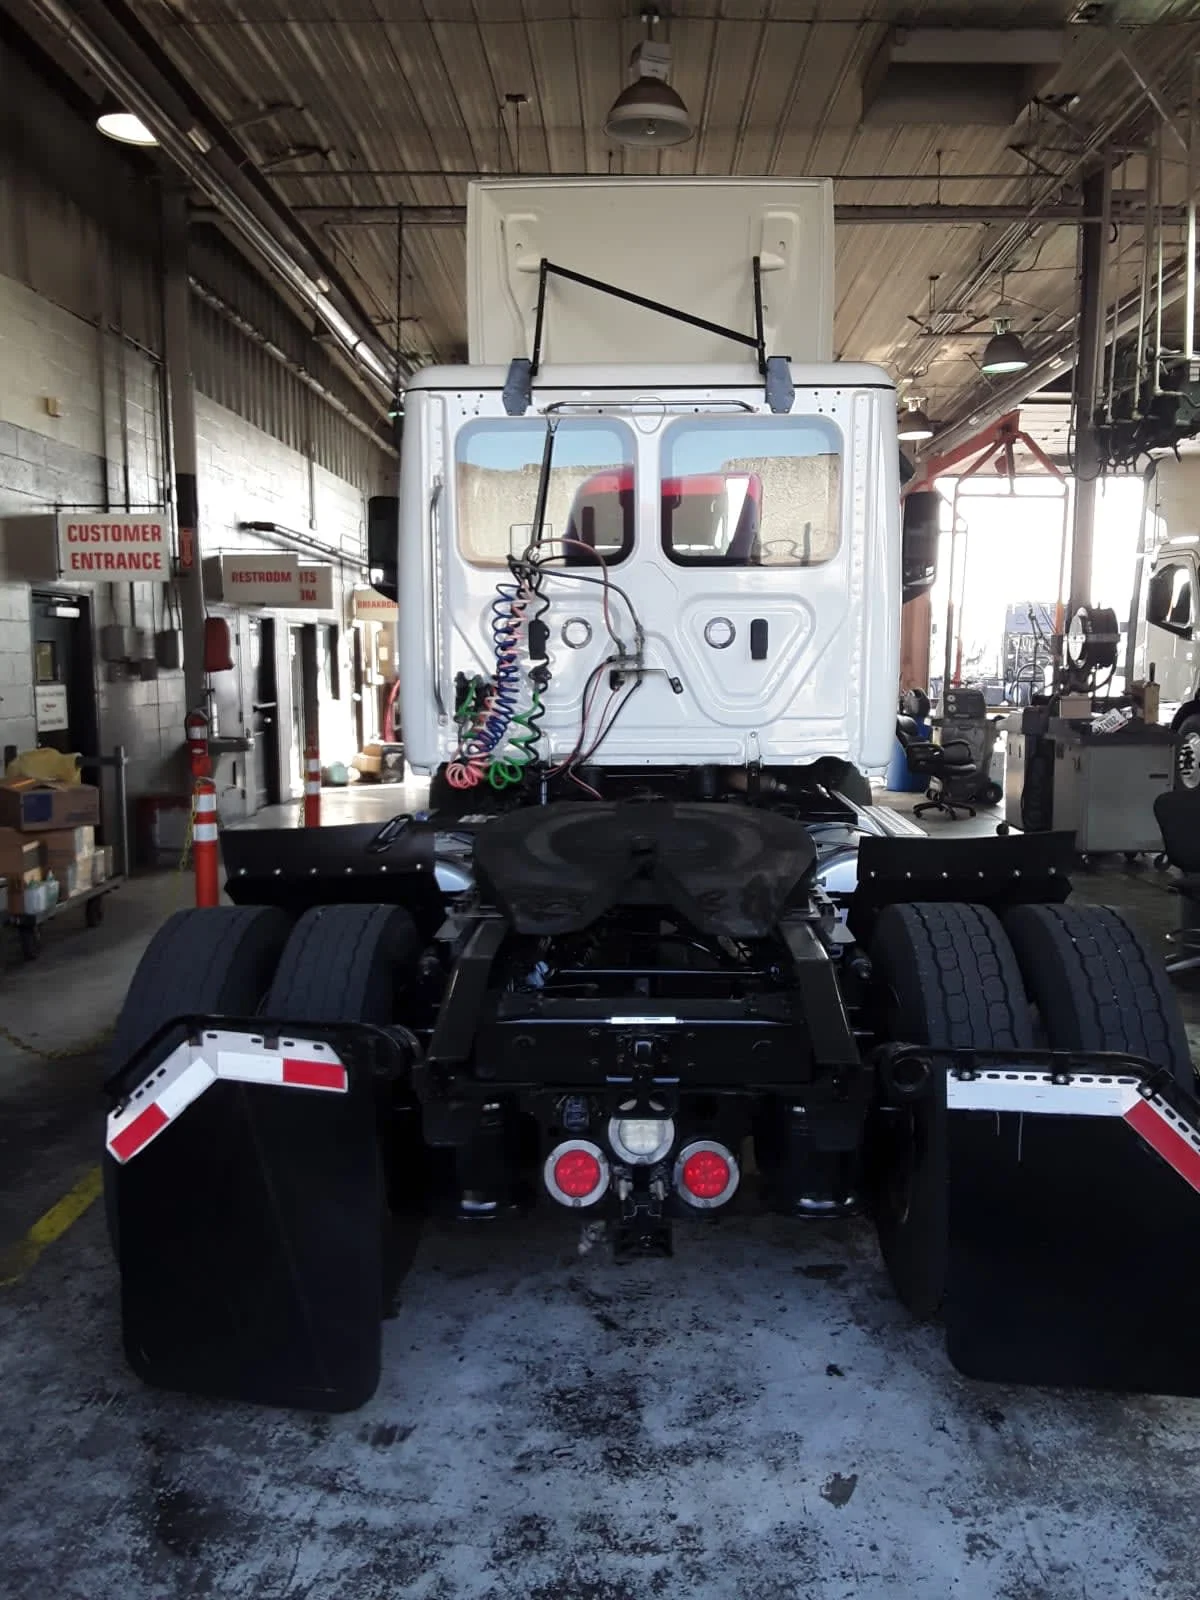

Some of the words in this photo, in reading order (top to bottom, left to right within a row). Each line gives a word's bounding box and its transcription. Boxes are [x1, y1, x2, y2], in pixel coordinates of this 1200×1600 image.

[67, 524, 162, 542] CUSTOMER
[71, 552, 162, 570] ENTRANCE
[231, 571, 292, 583] RESTROOM
